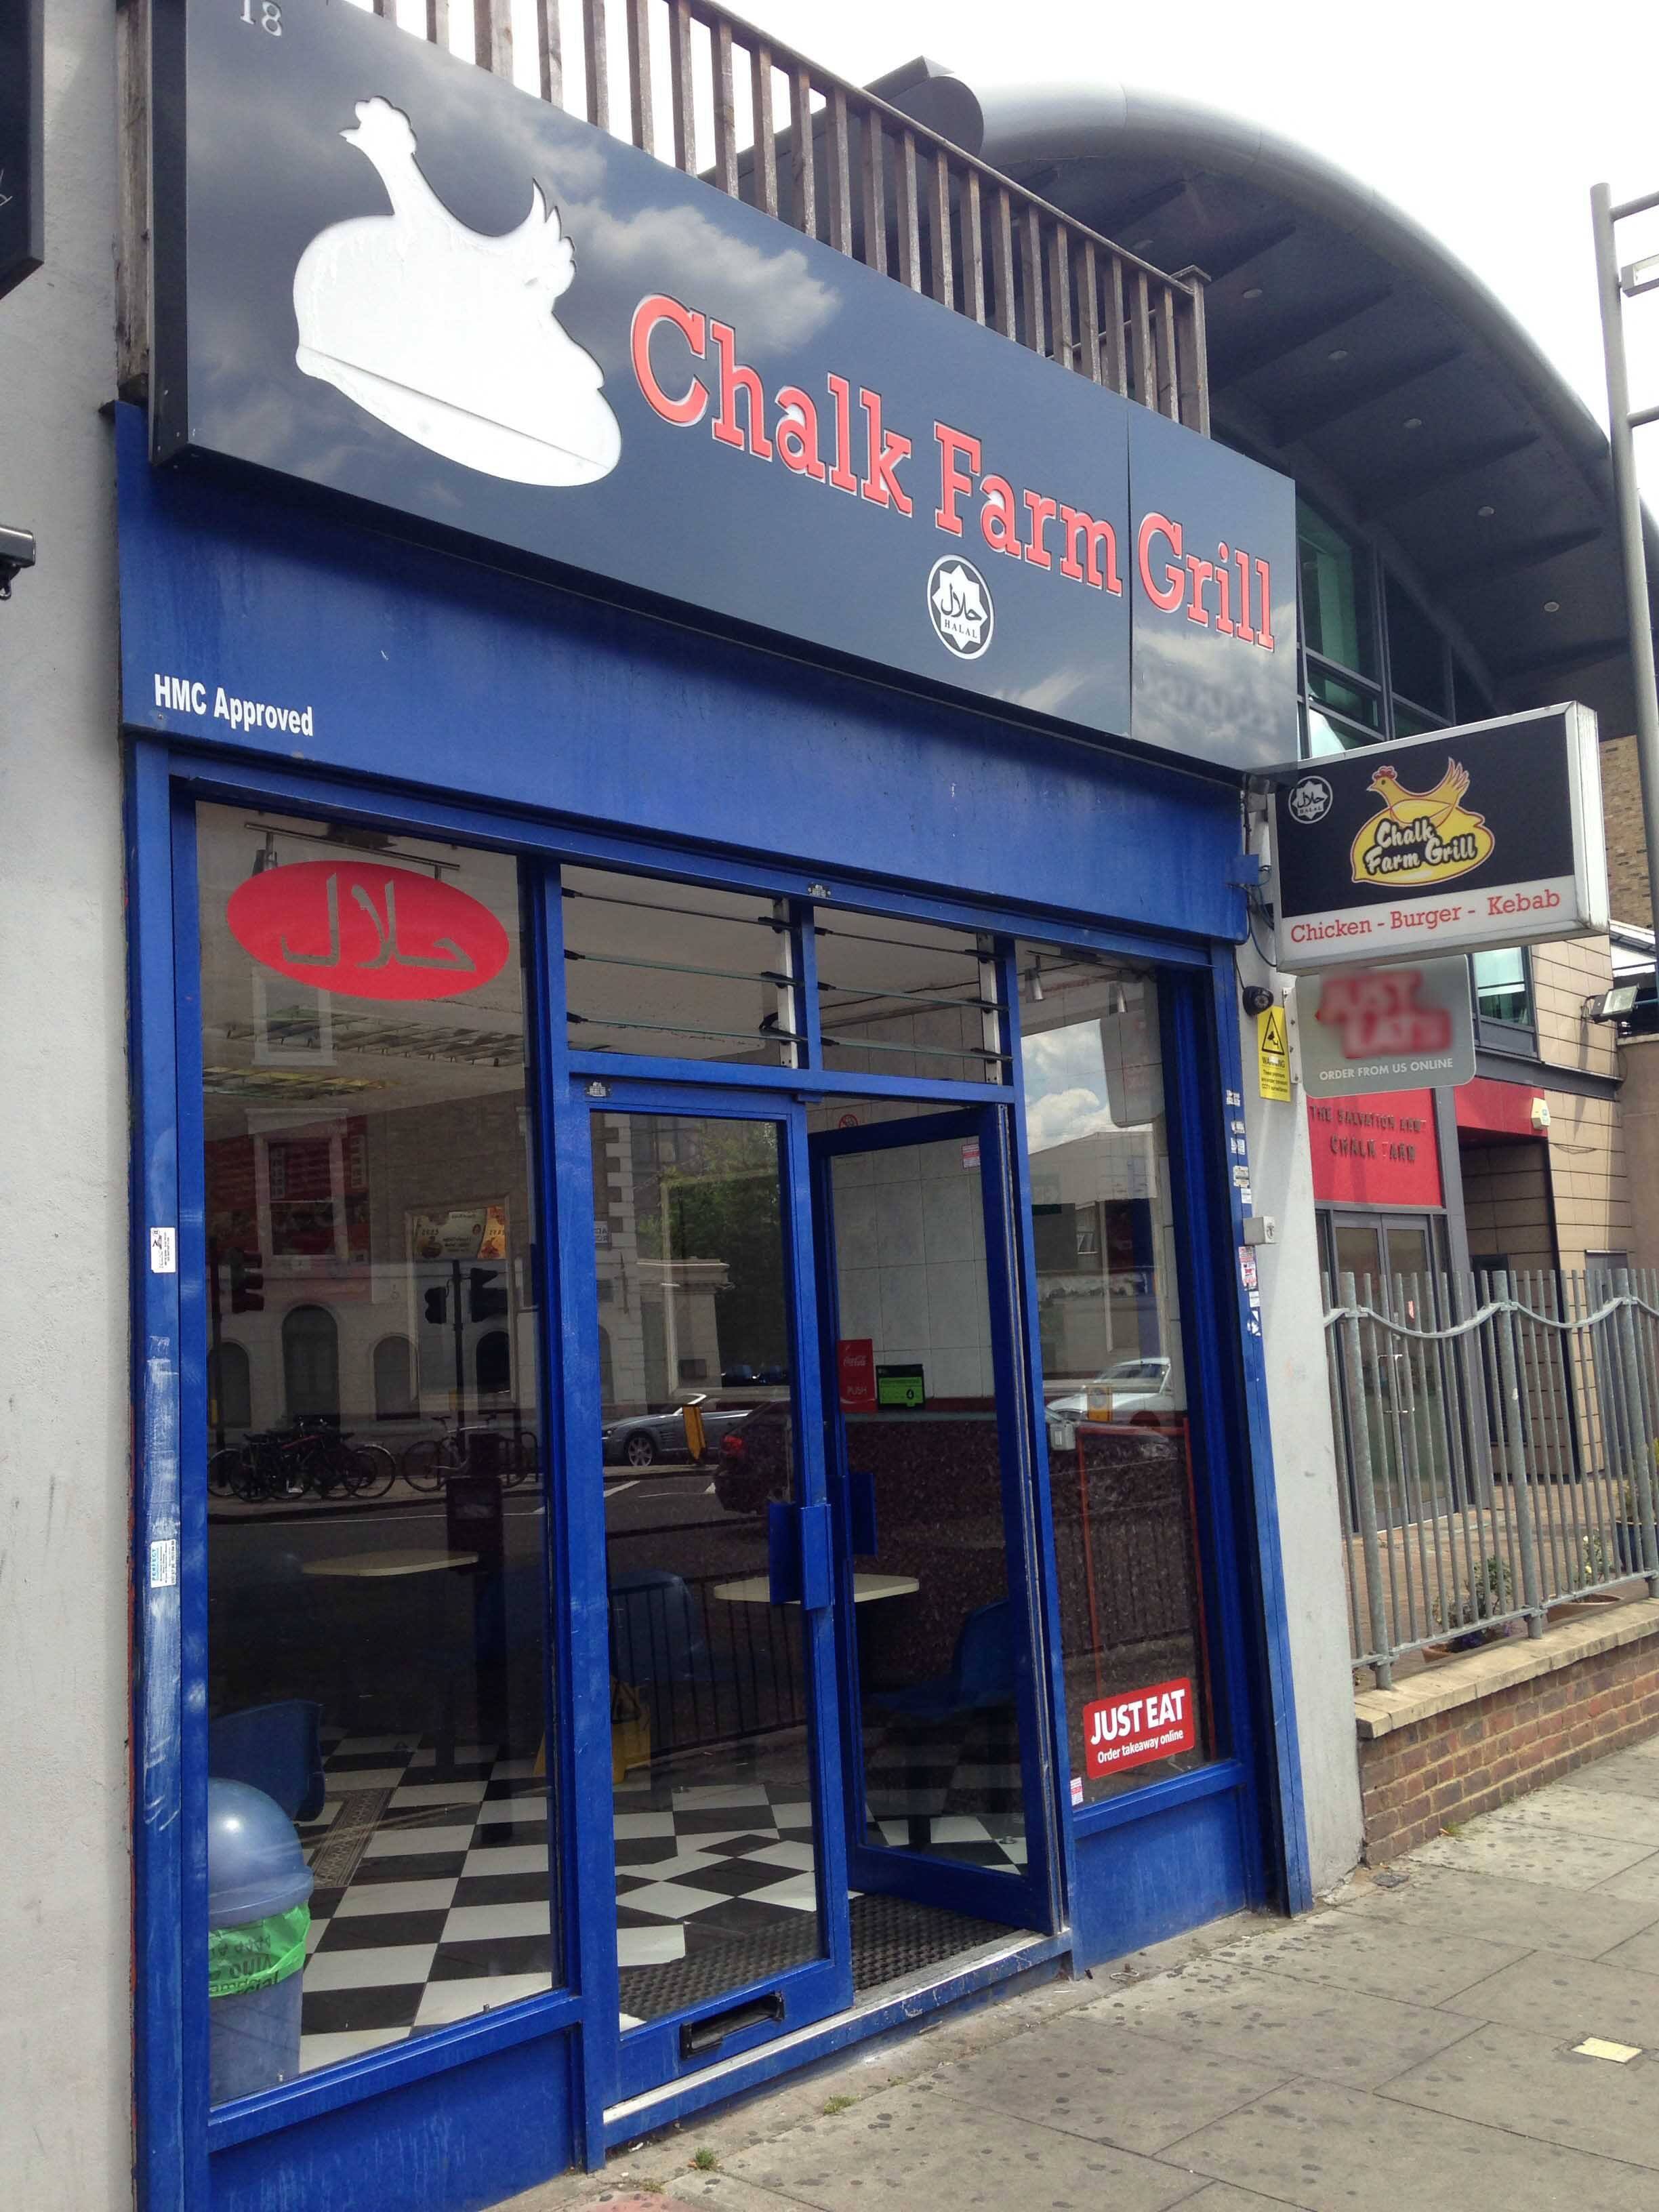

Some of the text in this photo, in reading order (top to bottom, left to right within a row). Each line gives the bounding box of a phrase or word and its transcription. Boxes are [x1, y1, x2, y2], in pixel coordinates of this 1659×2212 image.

[240, 0, 282, 37] 18
[630, 293, 1274, 653] Chalk Farm Grill
[941, 583, 982, 621] حلال
[944, 619, 977, 638] HALAL
[155, 674, 314, 737] HMC Approved
[1375, 817, 1434, 848] Chalk
[1364, 835, 1477, 874] Farm Grill
[280, 872, 477, 973] حلال
[1290, 918, 1372, 943] Chicken
[1390, 905, 1462, 929] Burger
[1488, 889, 1560, 915] Kebab
[1319, 1058, 1453, 1081] ORDER FROM US ONLINE
[1310, 1105, 1332, 1122] THE
[1338, 1109, 1395, 1130] SALVATION
[1330, 1134, 1376, 1158] CHALK
[847, 1386, 867, 1395] PUSH
[1090, 1689, 1185, 1745] JUST EAT
[1098, 1729, 1184, 1763] Order takeaway online
